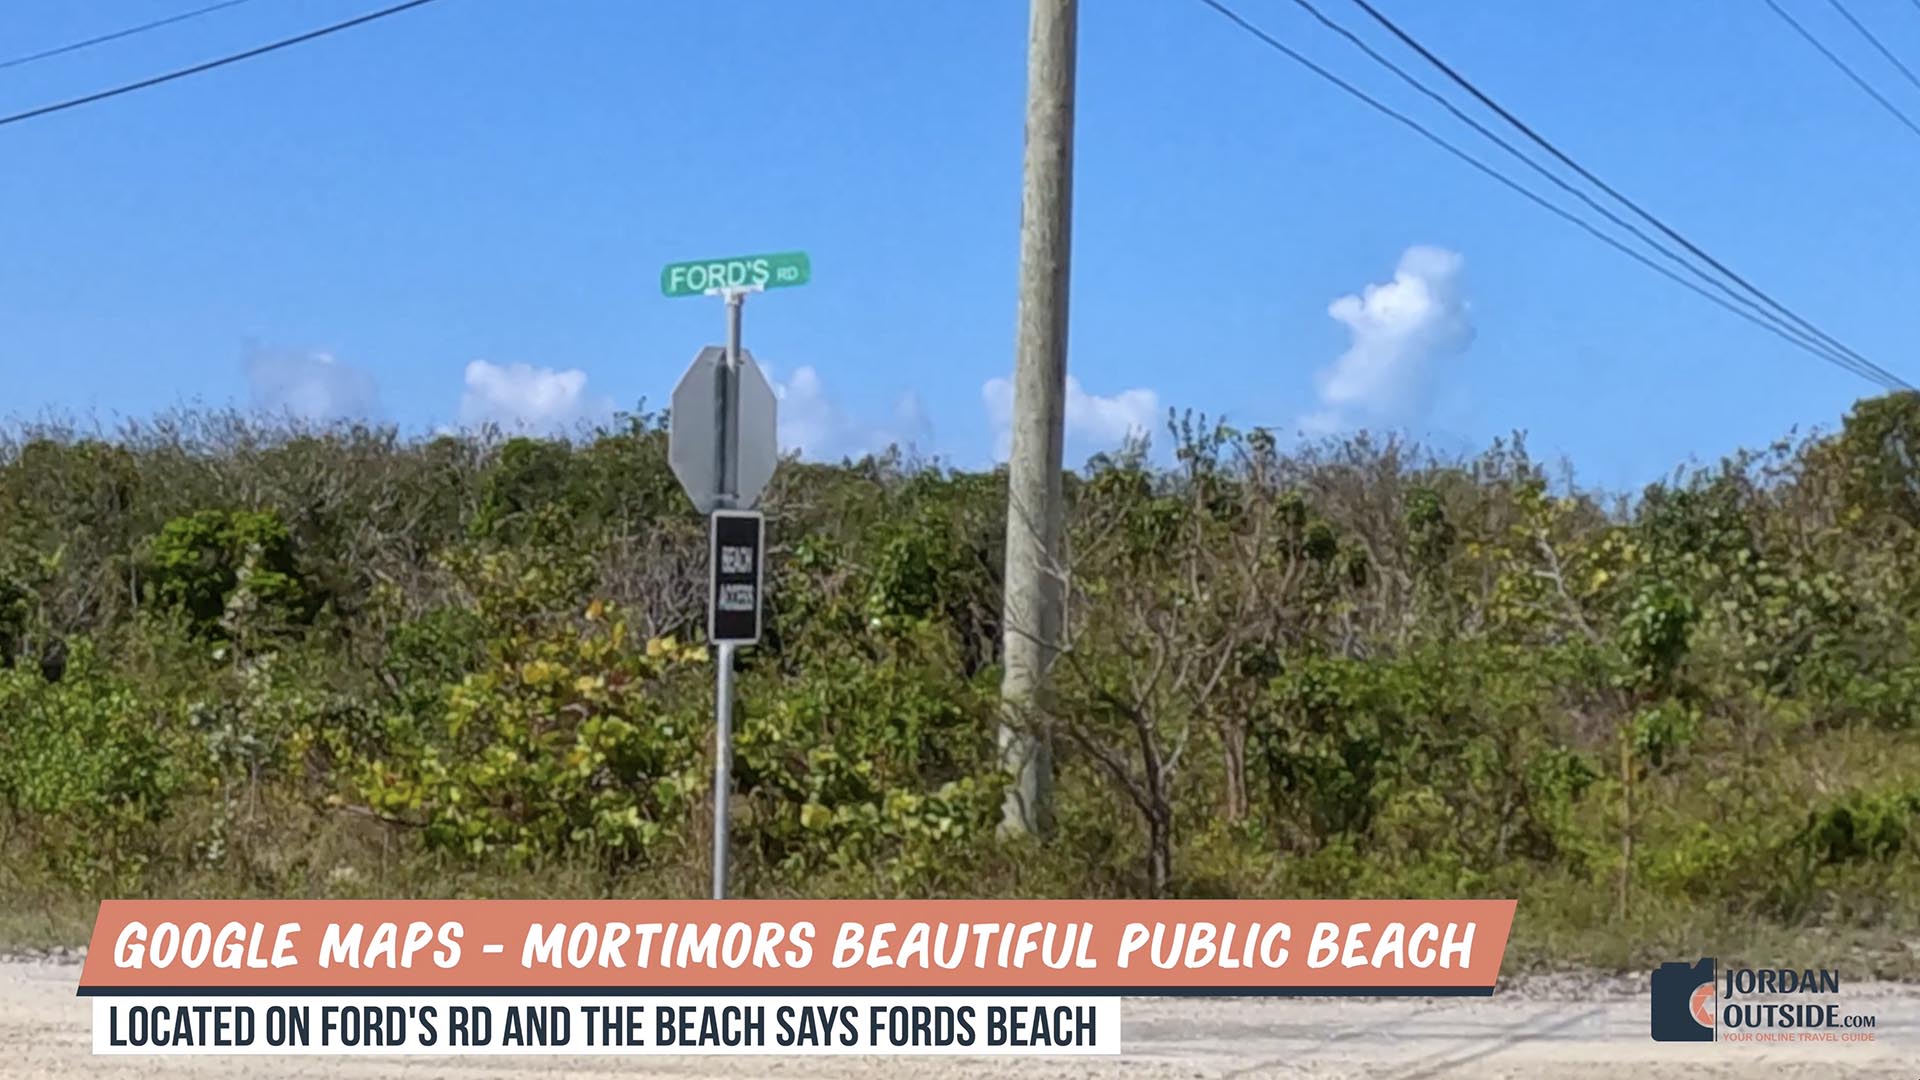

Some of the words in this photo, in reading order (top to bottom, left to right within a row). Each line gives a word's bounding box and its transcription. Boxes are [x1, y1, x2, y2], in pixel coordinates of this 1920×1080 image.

[670, 259, 770, 292] FORD'S
[777, 266, 799, 281] RD
[721, 546, 753, 573] BEACH
